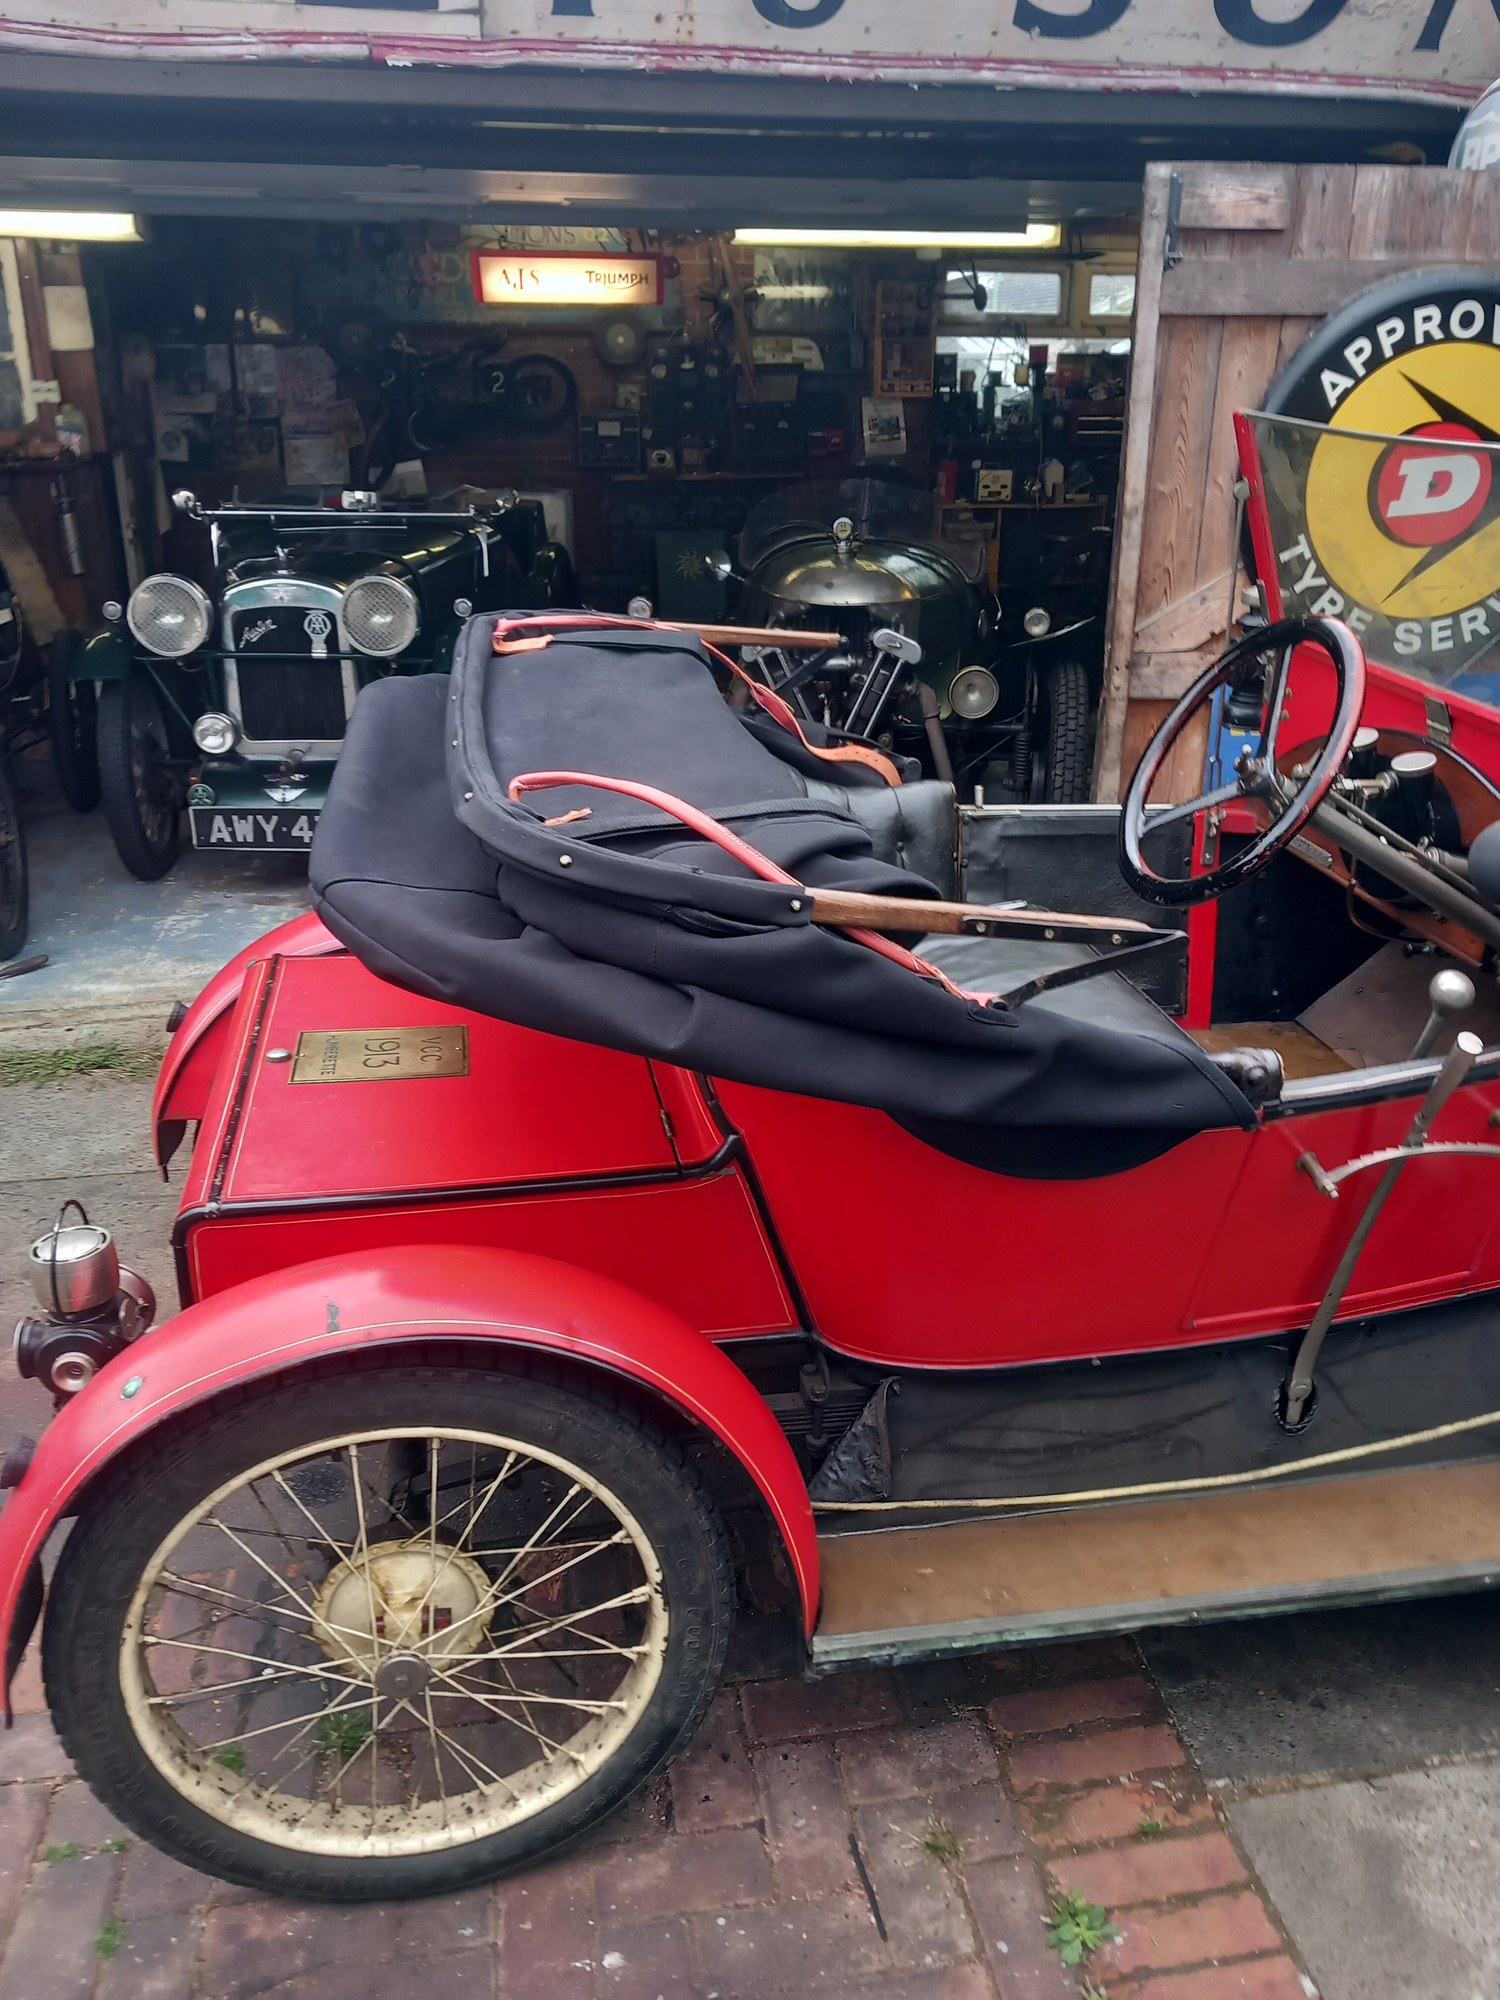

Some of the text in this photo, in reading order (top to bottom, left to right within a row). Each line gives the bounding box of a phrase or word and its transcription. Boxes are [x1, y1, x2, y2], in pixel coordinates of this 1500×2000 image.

[499, 268, 540, 290] AJS
[1320, 299, 1500, 408] APPRO
[490, 370, 506, 394] 2
[1386, 452, 1481, 517] D
[290, 815, 321, 843] 4
[363, 1037, 400, 1069] 1913
